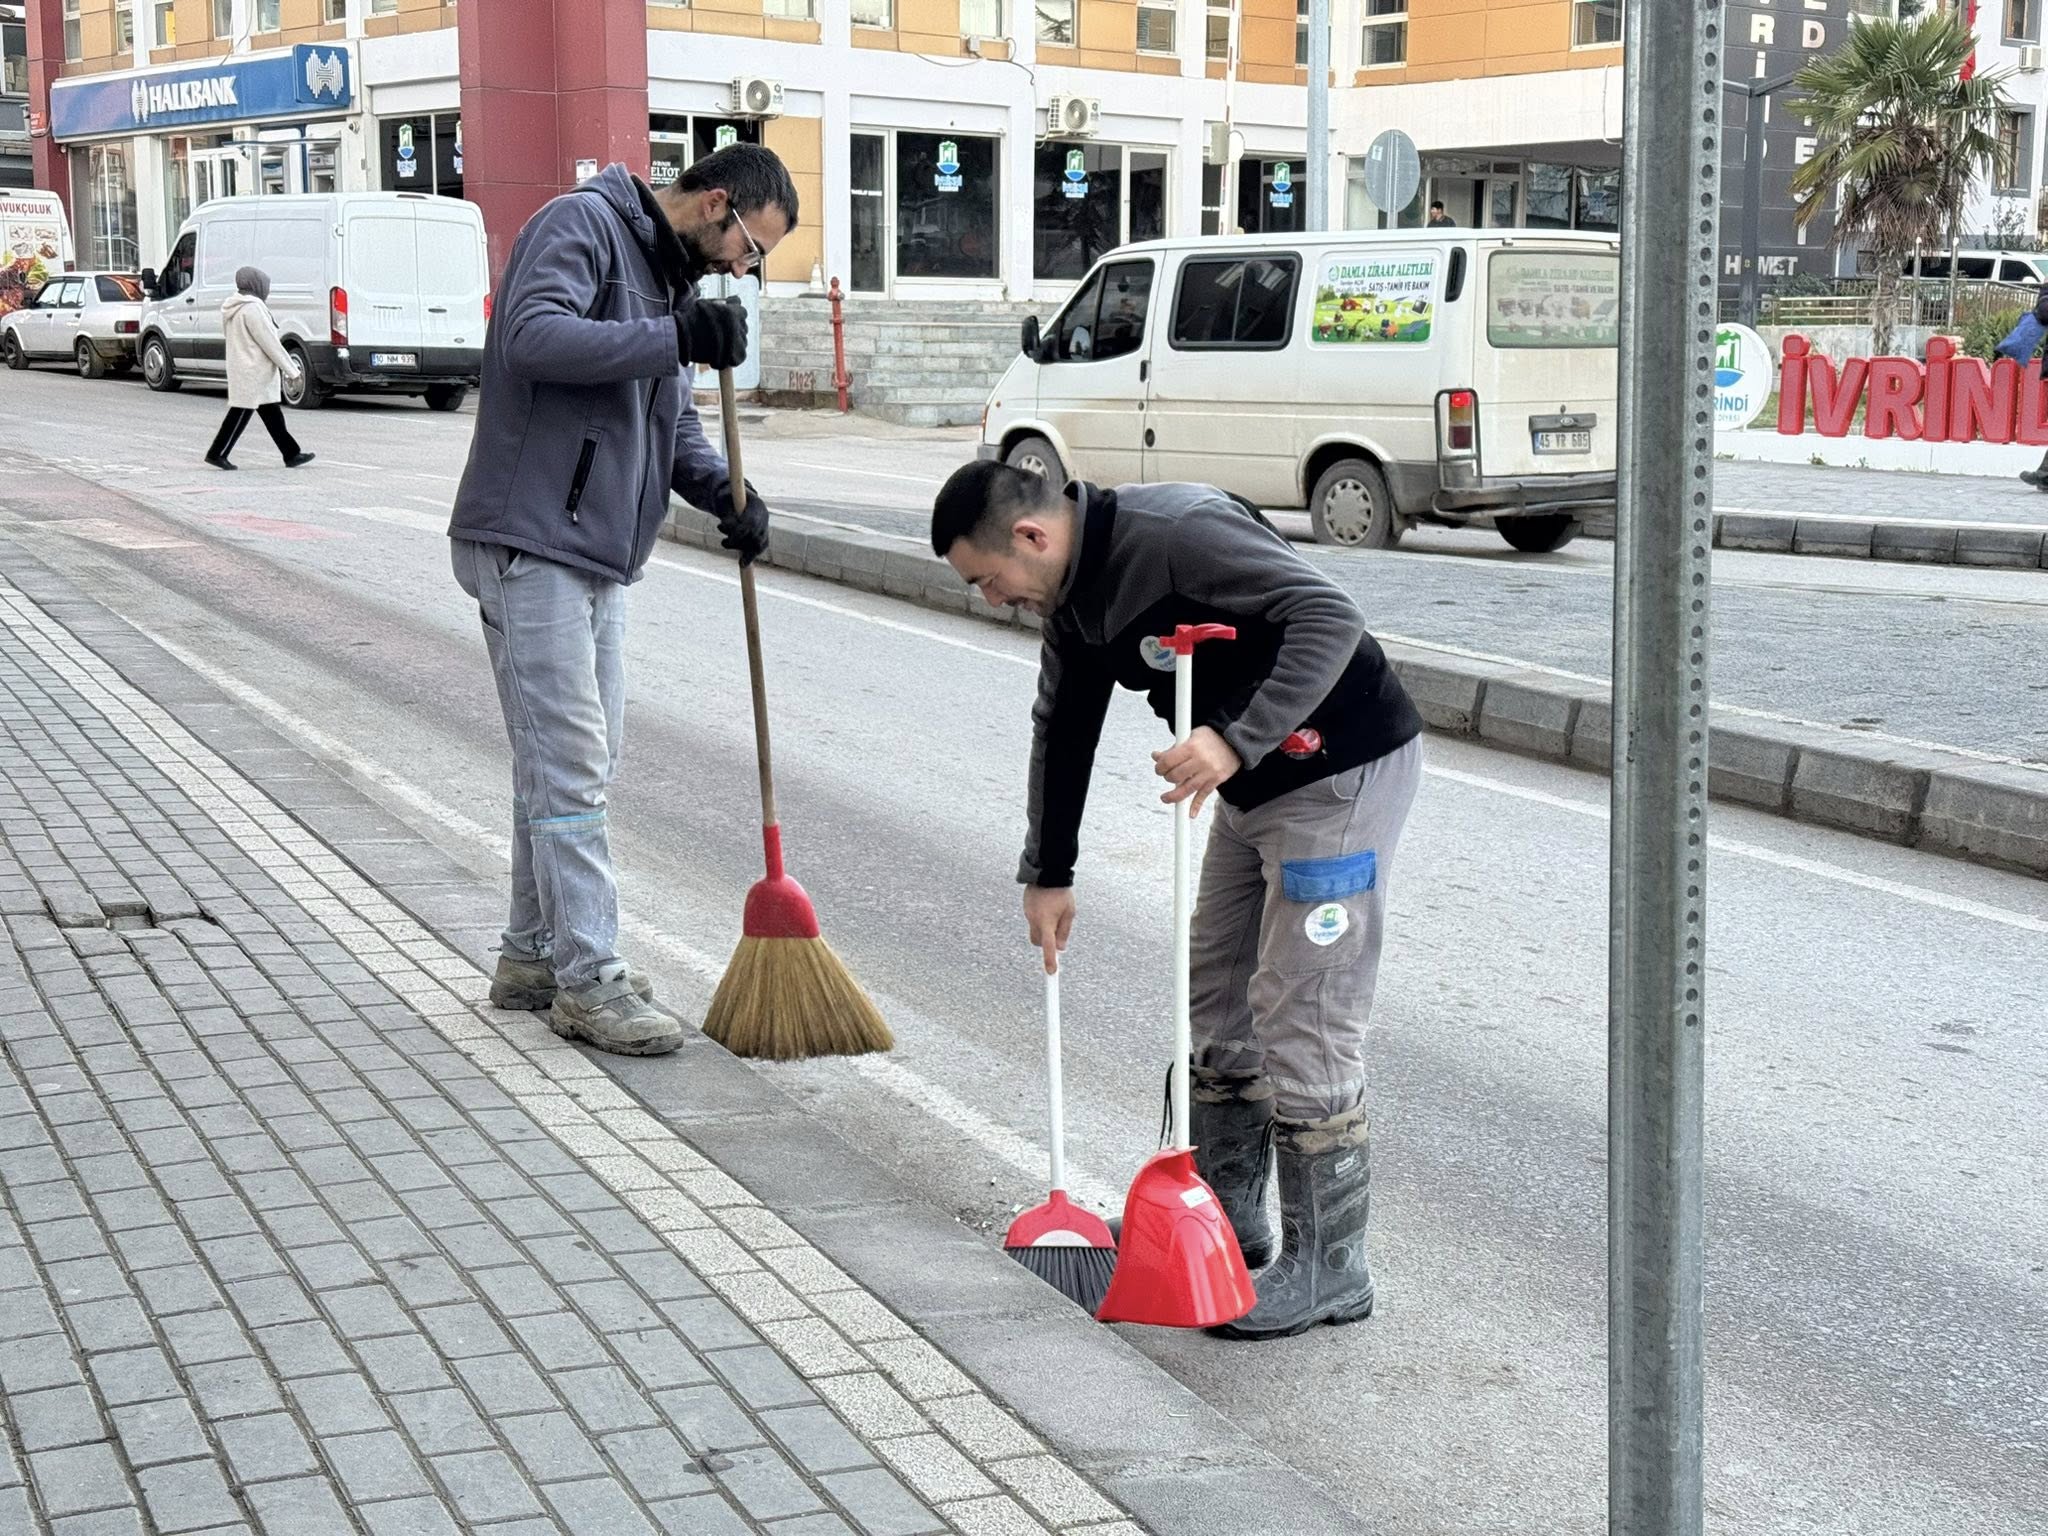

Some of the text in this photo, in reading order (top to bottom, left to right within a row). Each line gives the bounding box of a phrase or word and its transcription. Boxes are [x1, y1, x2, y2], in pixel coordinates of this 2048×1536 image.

[149, 76, 238, 113] HALKBANK
[1396, 258, 1434, 276] ALETLERİ
[1725, 254, 1798, 275] HMET
